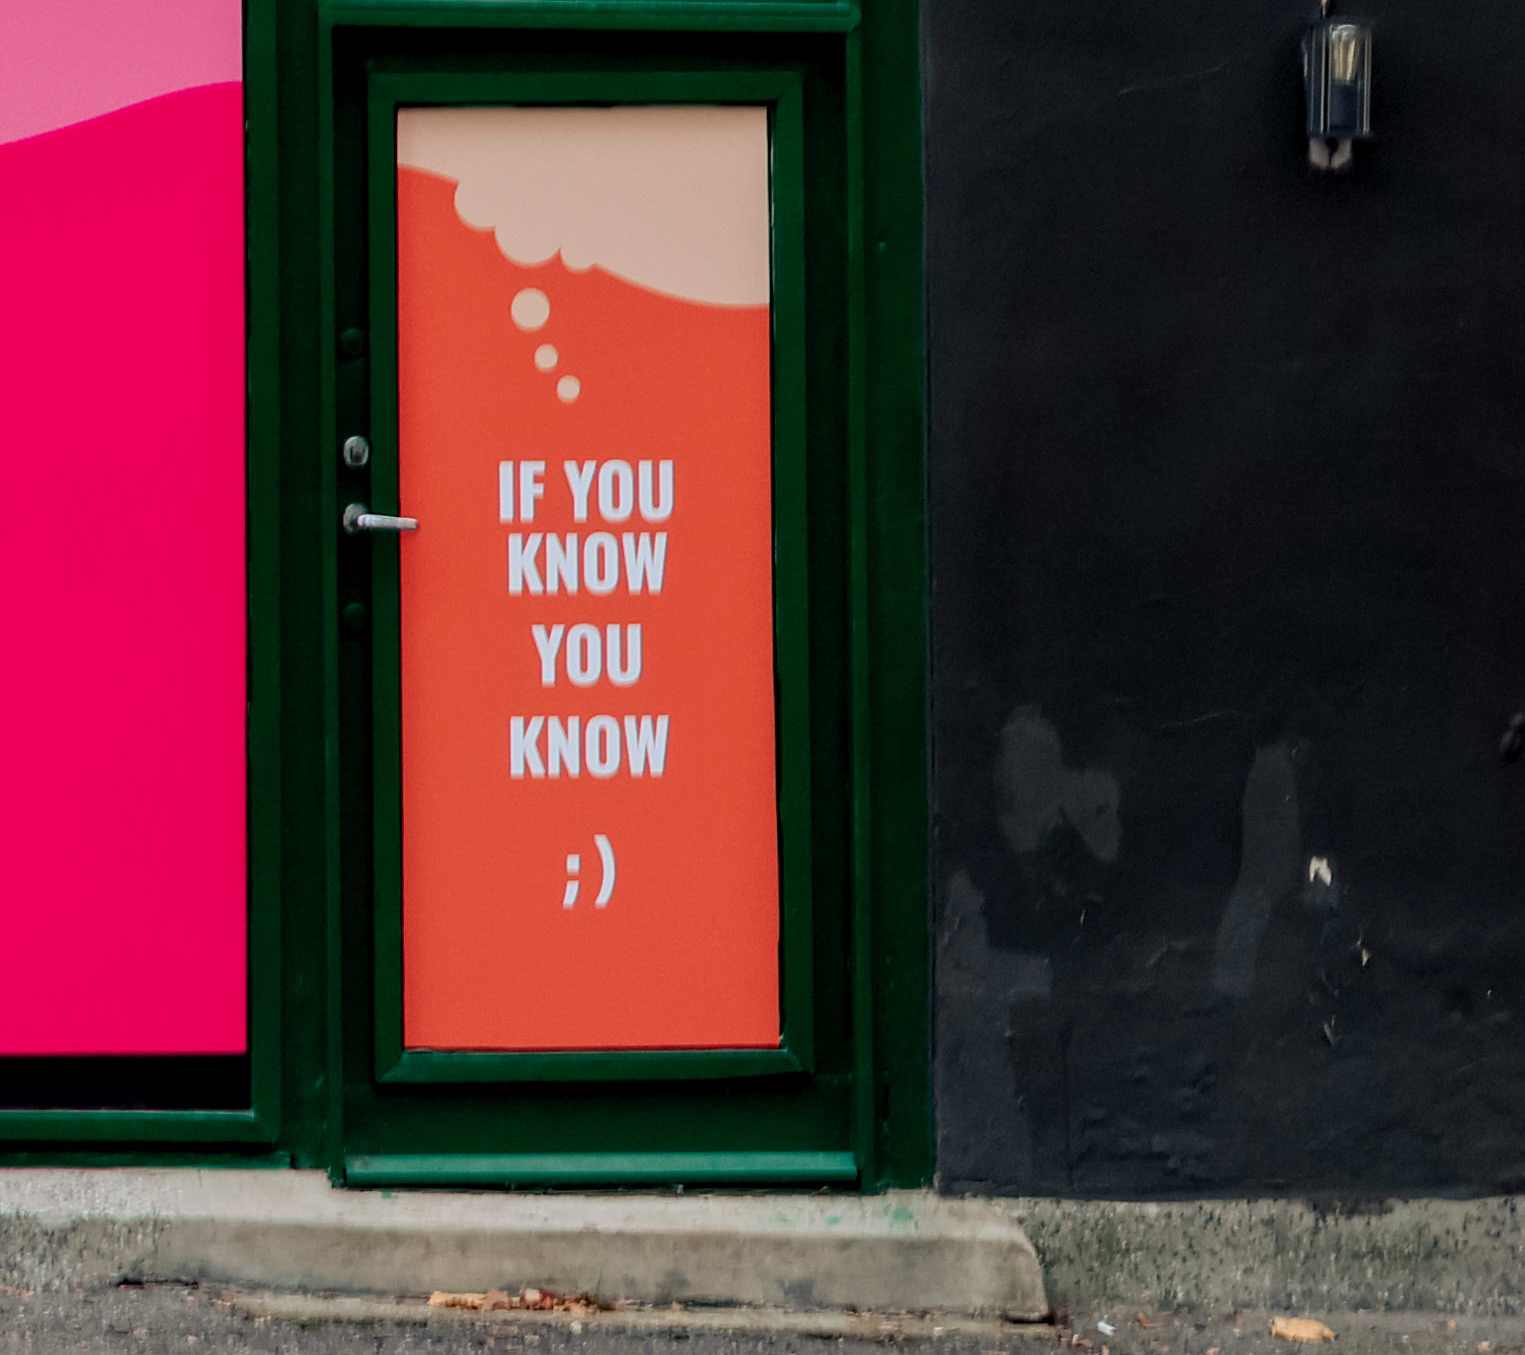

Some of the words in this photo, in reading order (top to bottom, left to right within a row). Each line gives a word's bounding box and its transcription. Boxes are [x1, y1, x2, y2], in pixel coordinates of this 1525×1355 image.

[498, 460, 546, 523] IF
[563, 459, 674, 523] YOU
[508, 531, 668, 595] KNOW
[531, 623, 642, 687] YOU
[509, 714, 669, 778] KNOW
